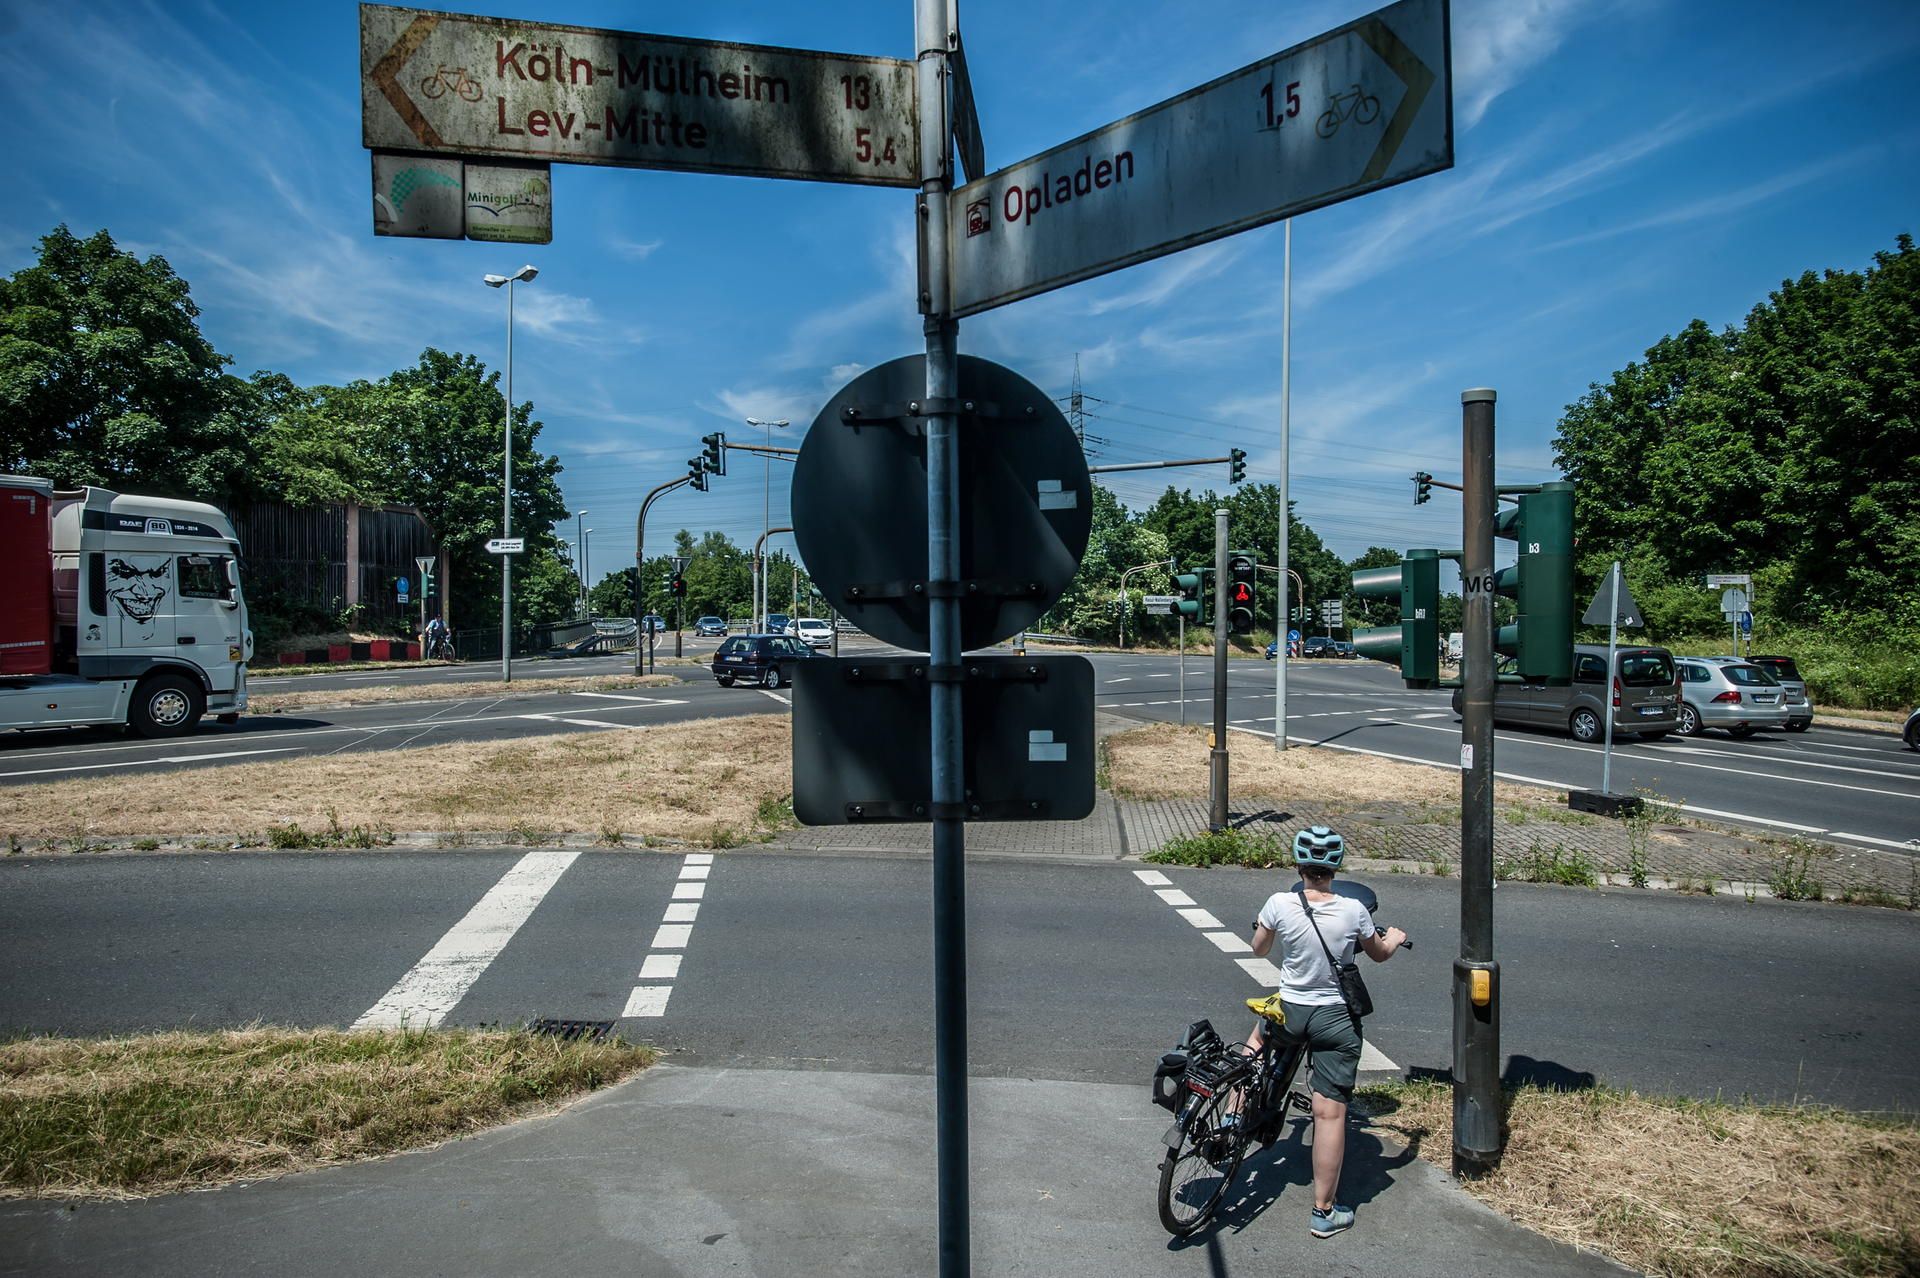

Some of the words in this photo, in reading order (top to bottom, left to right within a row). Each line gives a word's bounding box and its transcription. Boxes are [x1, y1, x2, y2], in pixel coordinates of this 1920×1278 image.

[496, 40, 790, 104] Köln-Mülheim
[839, 74, 871, 112] 13
[1259, 81, 1301, 128] 1,5
[497, 97, 708, 150] Lev.-Mitte
[855, 128, 897, 166] 5,4
[467, 192, 518, 207] Minigolf
[1003, 149, 1133, 225] Opladen
[119, 519, 143, 528] DAF
[1529, 543, 1540, 554] b3
[1464, 575, 1494, 593] M6
